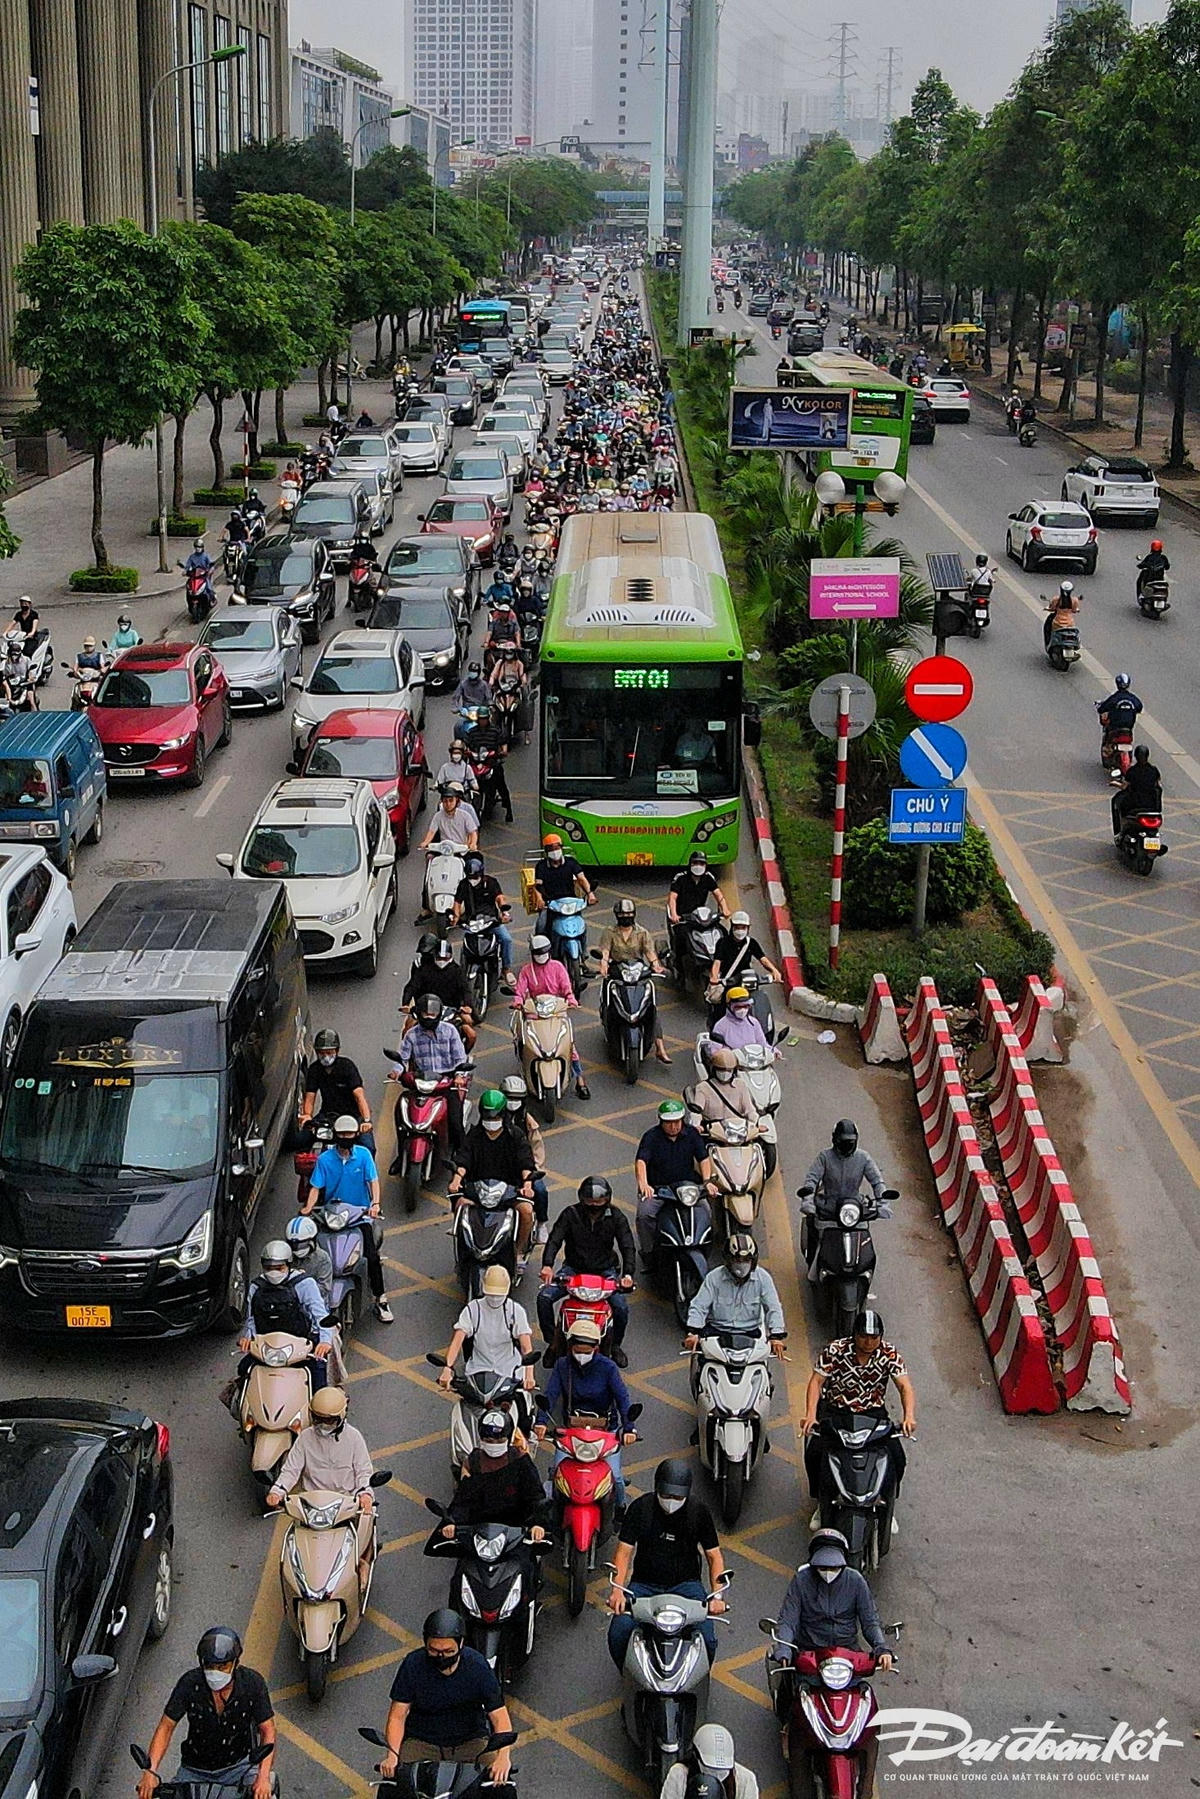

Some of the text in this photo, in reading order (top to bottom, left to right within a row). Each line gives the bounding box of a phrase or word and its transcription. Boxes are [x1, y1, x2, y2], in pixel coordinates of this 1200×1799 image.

[906, 794, 950, 814] CHÚ Ý
[57, 1049, 180, 1061] LUXURY
[80, 1306, 97, 1316] 15E
